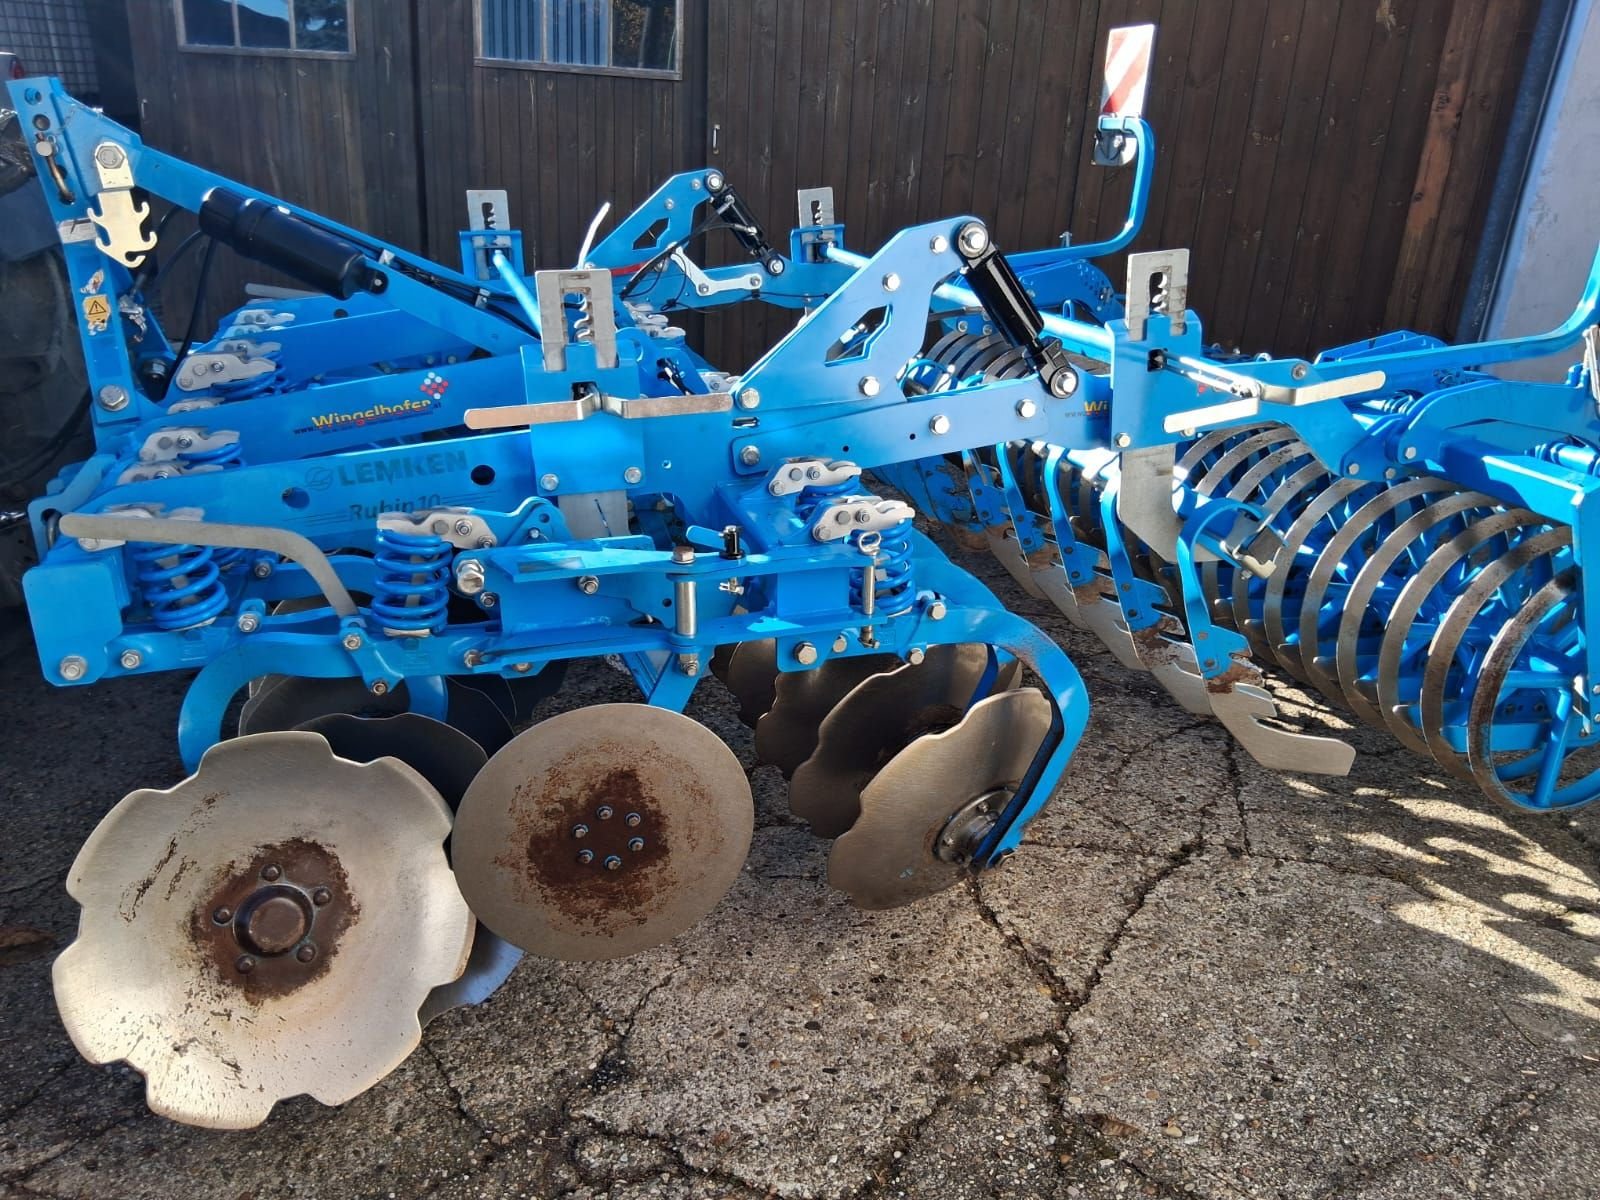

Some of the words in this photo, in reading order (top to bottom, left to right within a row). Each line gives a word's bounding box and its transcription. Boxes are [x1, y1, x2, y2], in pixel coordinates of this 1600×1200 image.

[338, 451, 467, 486] LEMKEN
[350, 498, 414, 520] Rubin
[417, 493, 441, 510] 10
